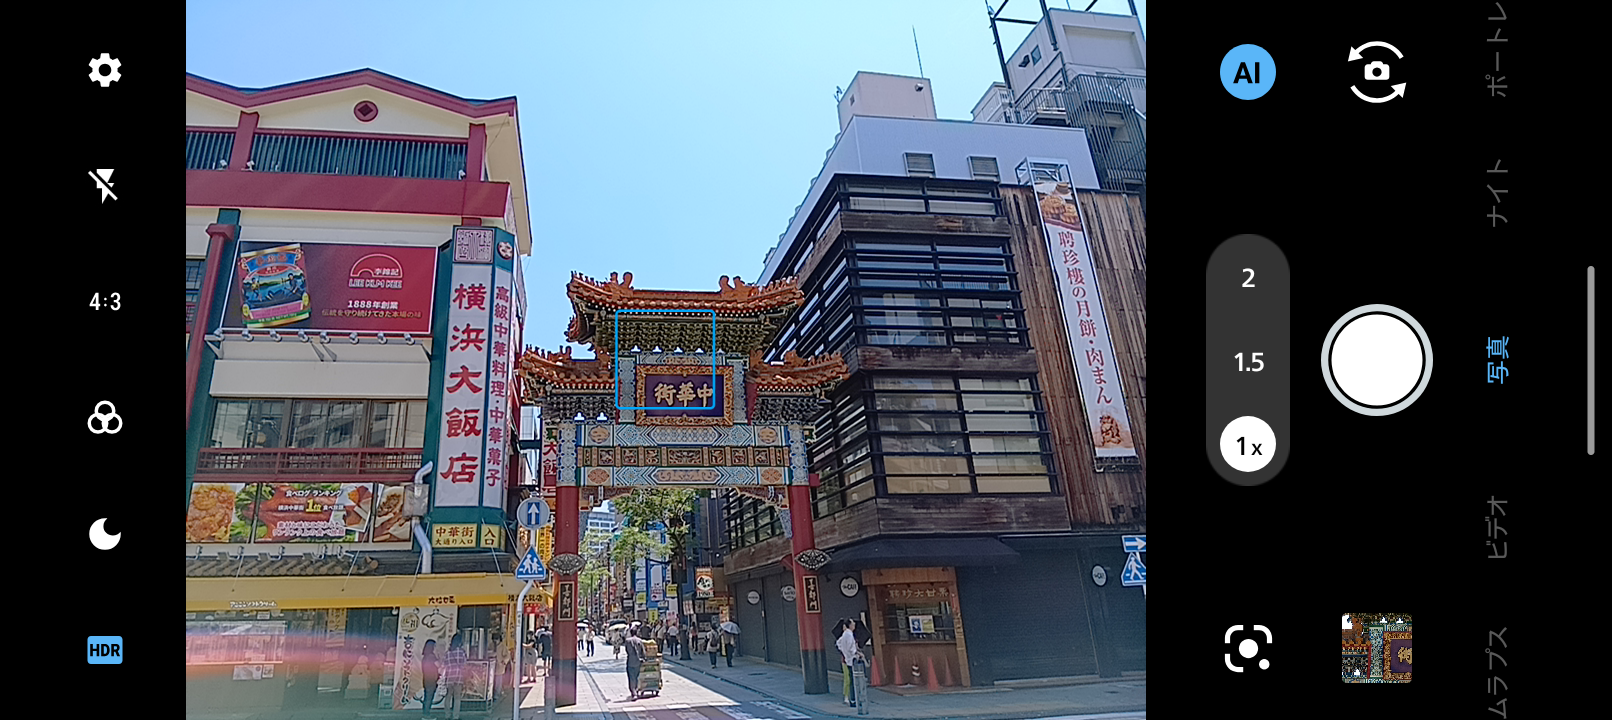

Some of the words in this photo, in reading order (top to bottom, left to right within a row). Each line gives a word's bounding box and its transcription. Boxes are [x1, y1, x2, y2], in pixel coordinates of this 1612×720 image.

[1232, 62, 1262, 84] AI
[1486, 159, 1509, 228] ナイト
[348, 278, 365, 288] LEE
[385, 280, 403, 290] KEE
[1241, 267, 1256, 288] 2
[88, 291, 122, 312] 4:3
[347, 299, 398, 310] 1888年創業
[1234, 352, 1265, 373] 1.5
[1485, 335, 1510, 385] 写真
[440, 283, 487, 485] 横浜大飯店
[285, 489, 310, 498] 食べログ
[312, 489, 343, 498] ランキング
[305, 498, 322, 512] 1位
[435, 526, 475, 538] 中華街
[484, 527, 497, 546] 入口
[1484, 495, 1508, 559] ビデオ
[435, 538, 474, 546] 大通り入口
[89, 643, 121, 657] HDR
